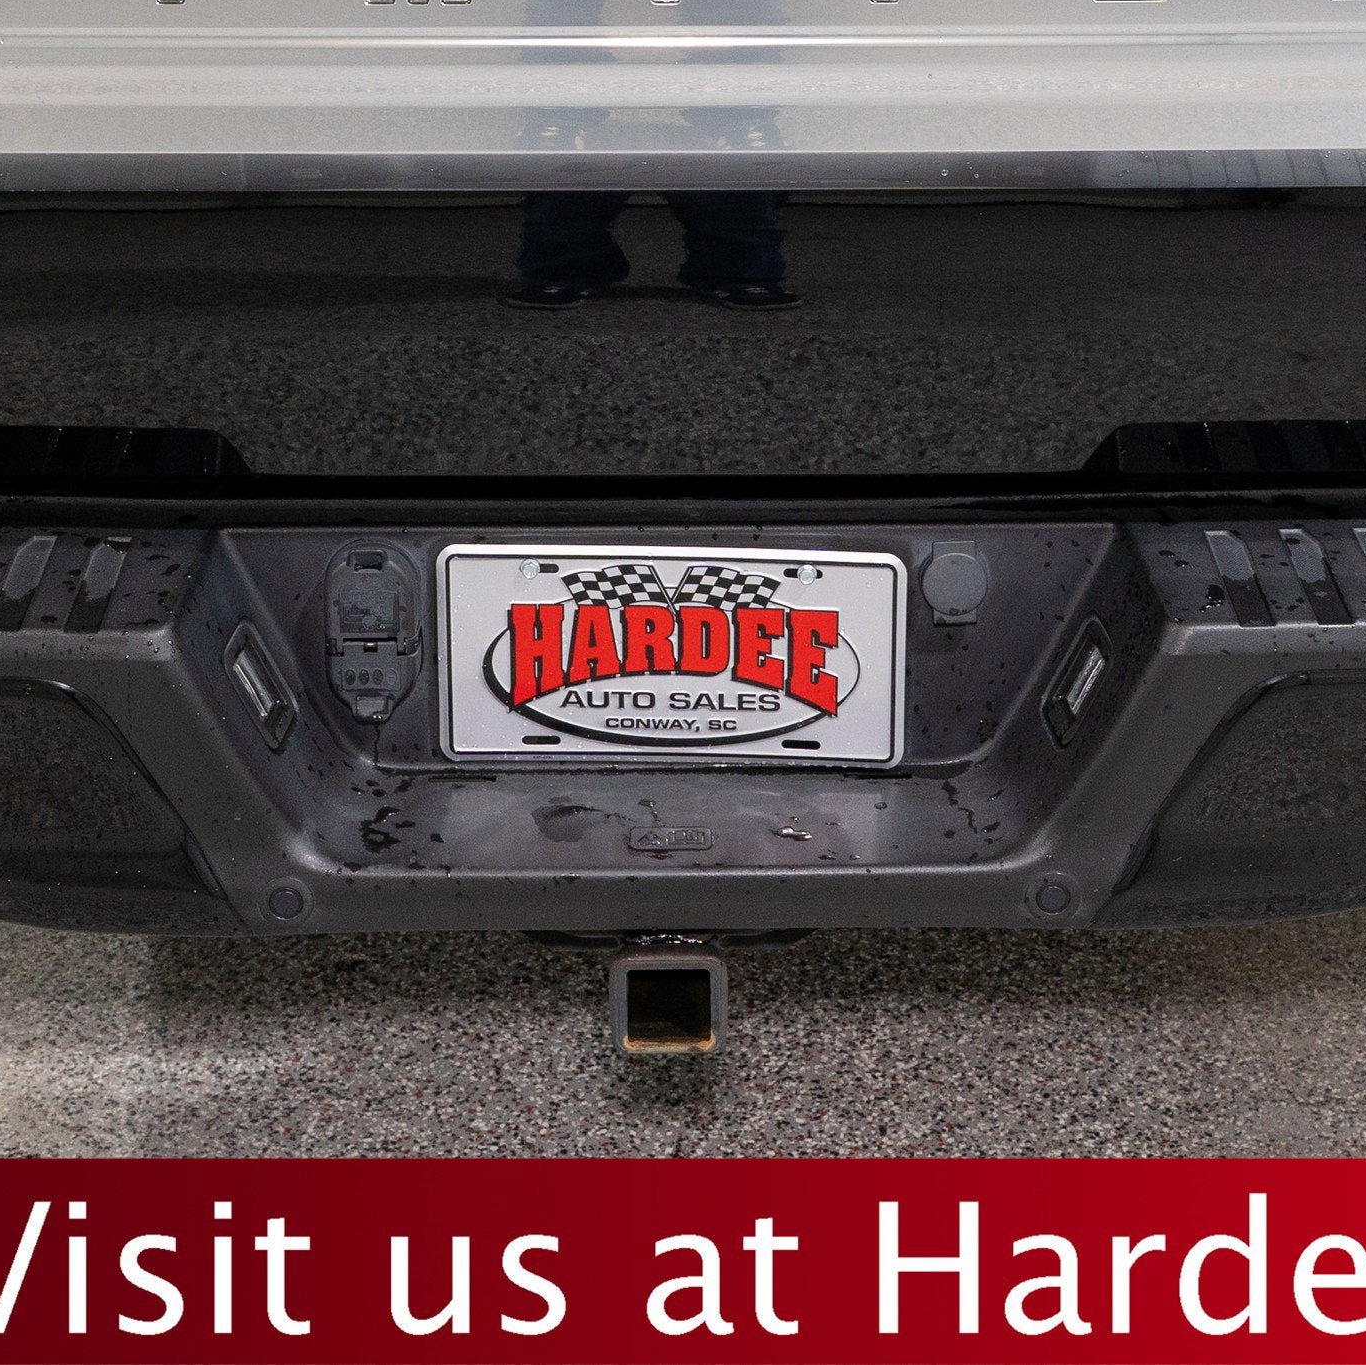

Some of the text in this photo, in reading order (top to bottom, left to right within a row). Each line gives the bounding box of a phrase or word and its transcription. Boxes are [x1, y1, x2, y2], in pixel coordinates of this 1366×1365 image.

[507, 603, 839, 717] HARDEE
[560, 690, 781, 712] AUTO SALES
[605, 717, 738, 732] CONWAY, SC
